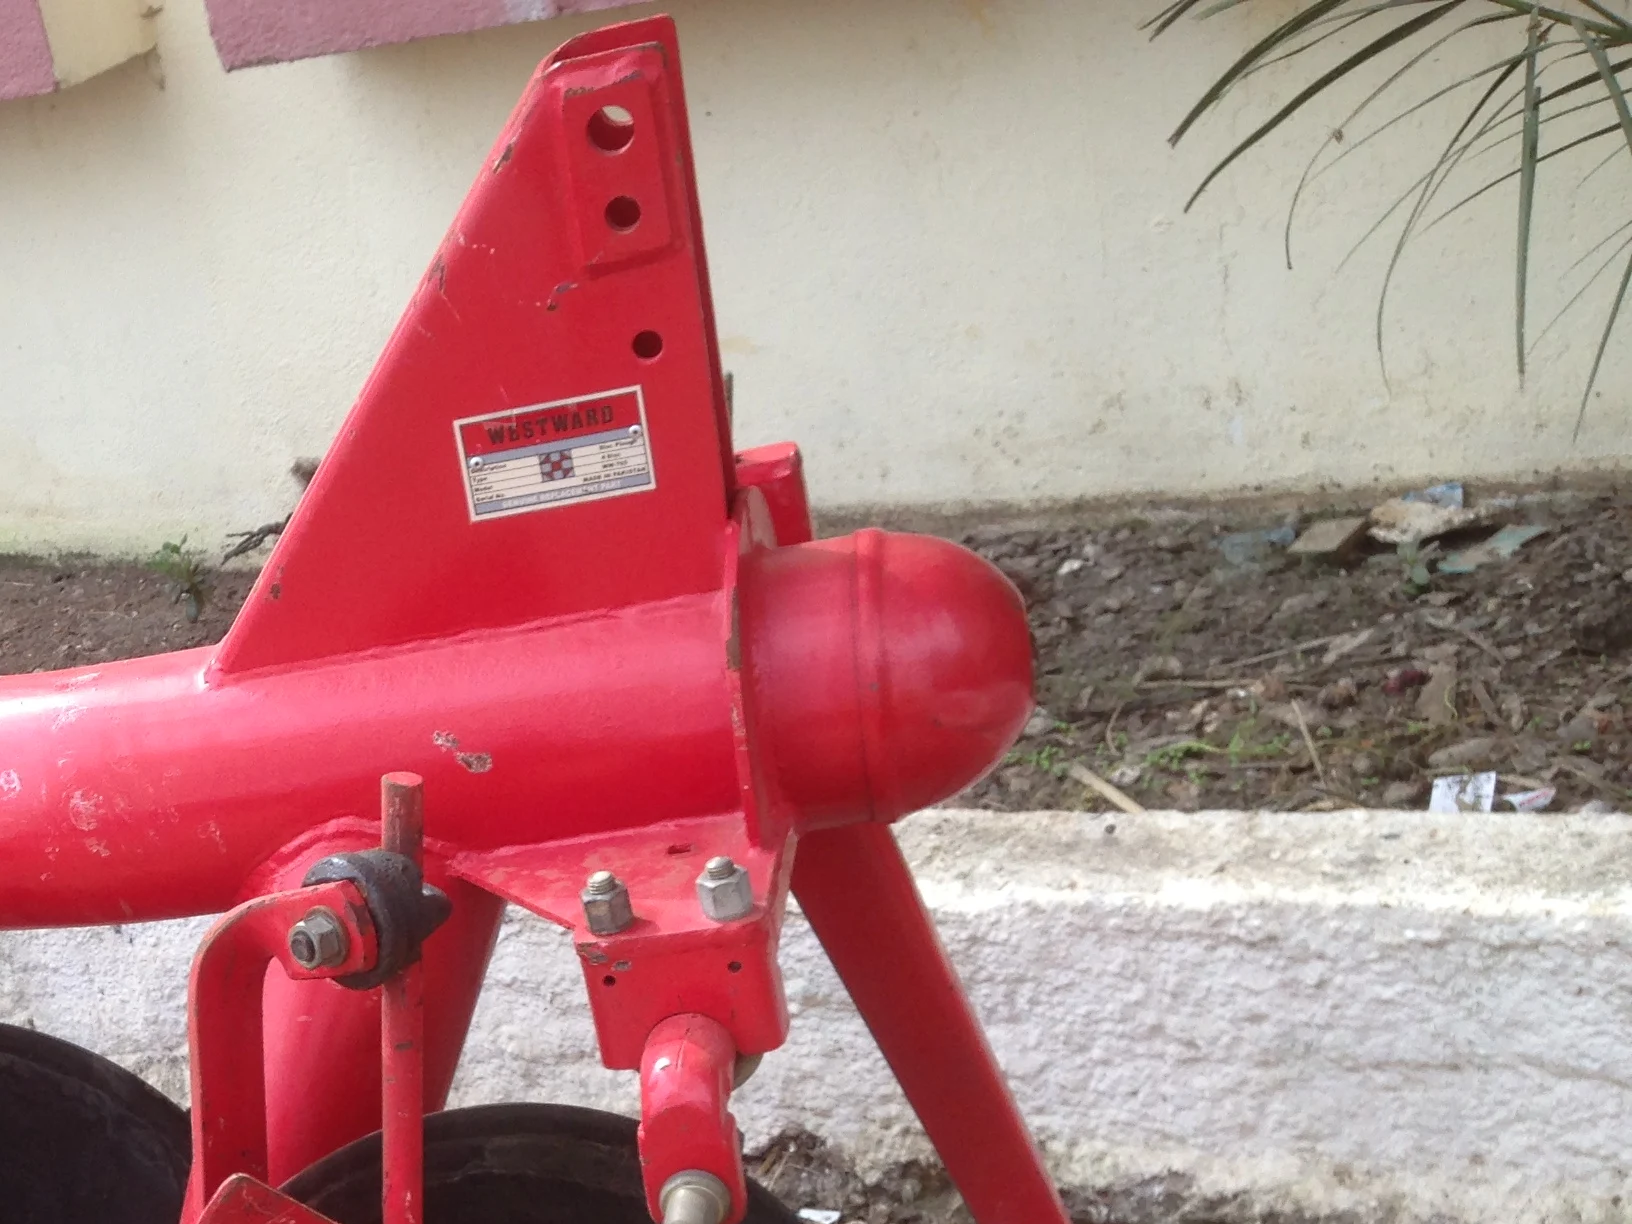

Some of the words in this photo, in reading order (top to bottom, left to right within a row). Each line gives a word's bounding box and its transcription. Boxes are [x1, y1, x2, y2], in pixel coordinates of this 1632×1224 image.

[486, 404, 614, 446] WESTWARD
[472, 474, 488, 483] Type
[582, 473, 601, 482] MADE
[612, 465, 646, 476] PAKISTAN
[473, 484, 493, 492] Model
[502, 496, 538, 508] GENUINE
[539, 484, 598, 502] REPLACEMENT
[599, 480, 622, 491] PART
[475, 494, 494, 502] Serial
